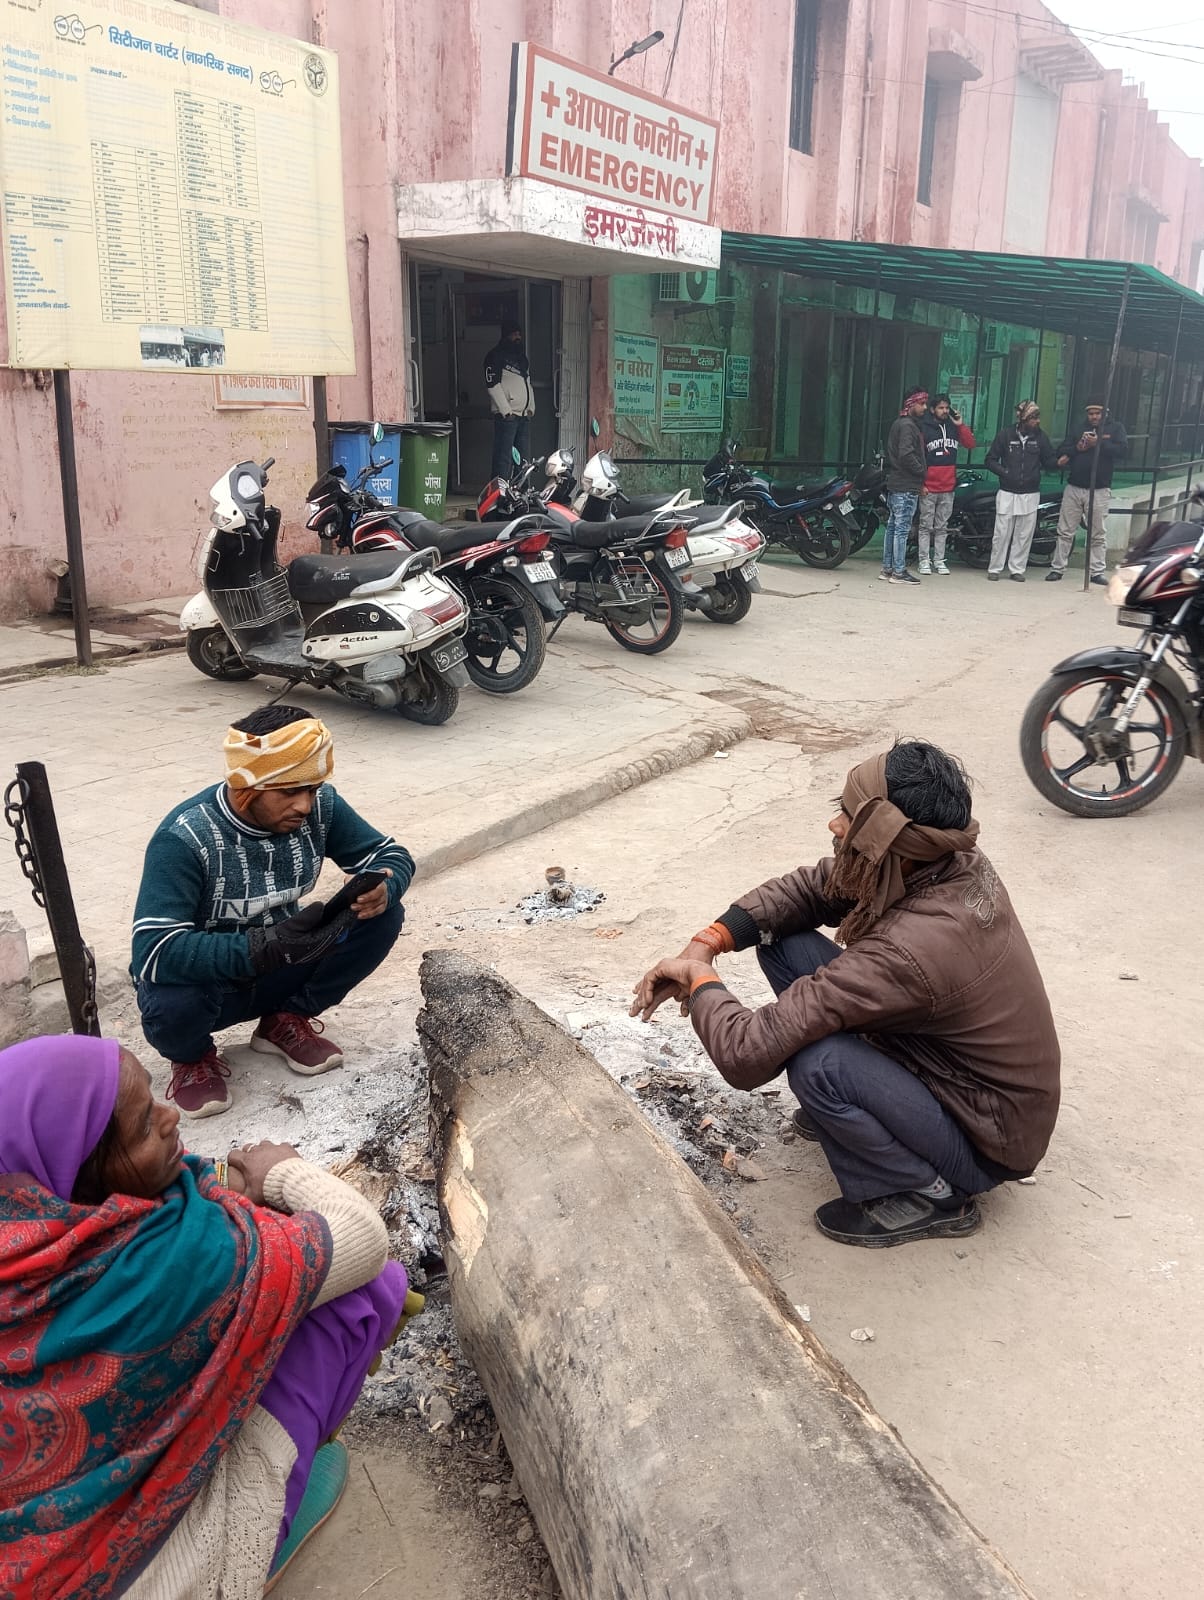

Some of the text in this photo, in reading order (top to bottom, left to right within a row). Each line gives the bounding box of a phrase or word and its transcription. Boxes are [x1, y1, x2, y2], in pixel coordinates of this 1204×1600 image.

[108, 25, 152, 53] सिटीजन
[154, 42, 179, 60] चार्टर
[181, 45, 225, 71] (नागरिक
[226, 62, 253, 84] सनद)
[563, 86, 694, 167] आपात कालीन
[539, 131, 705, 212] EMERGENCY
[627, 356, 654, 378] बसेरा
[371, 478, 392, 492] सूखा
[424, 472, 442, 490] गीला
[339, 634, 379, 644] Activa
